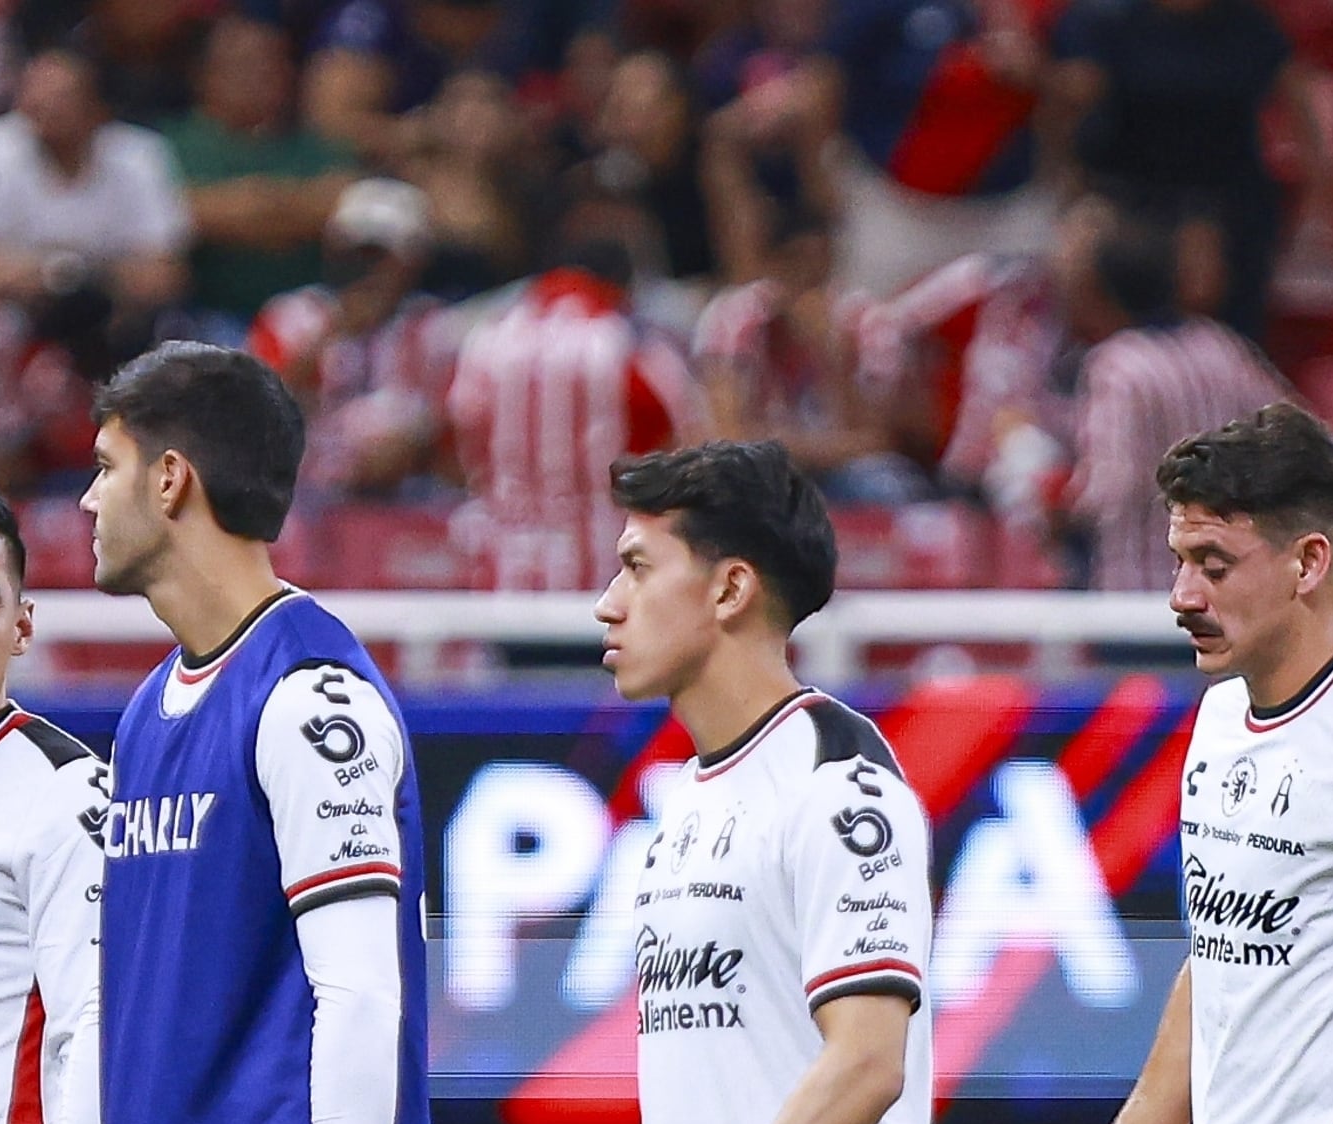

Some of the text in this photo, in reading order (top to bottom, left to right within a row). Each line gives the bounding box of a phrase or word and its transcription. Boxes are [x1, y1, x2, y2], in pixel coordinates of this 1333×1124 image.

[334, 751, 380, 787] Berel
[316, 799, 384, 819] Omnibus
[104, 792, 215, 858] CHARLY
[1247, 833, 1305, 856] PERDURA
[858, 851, 903, 882] Berel
[688, 882, 744, 902] PERDURA
[835, 893, 908, 914] Omnibus
[866, 912, 889, 932] de
